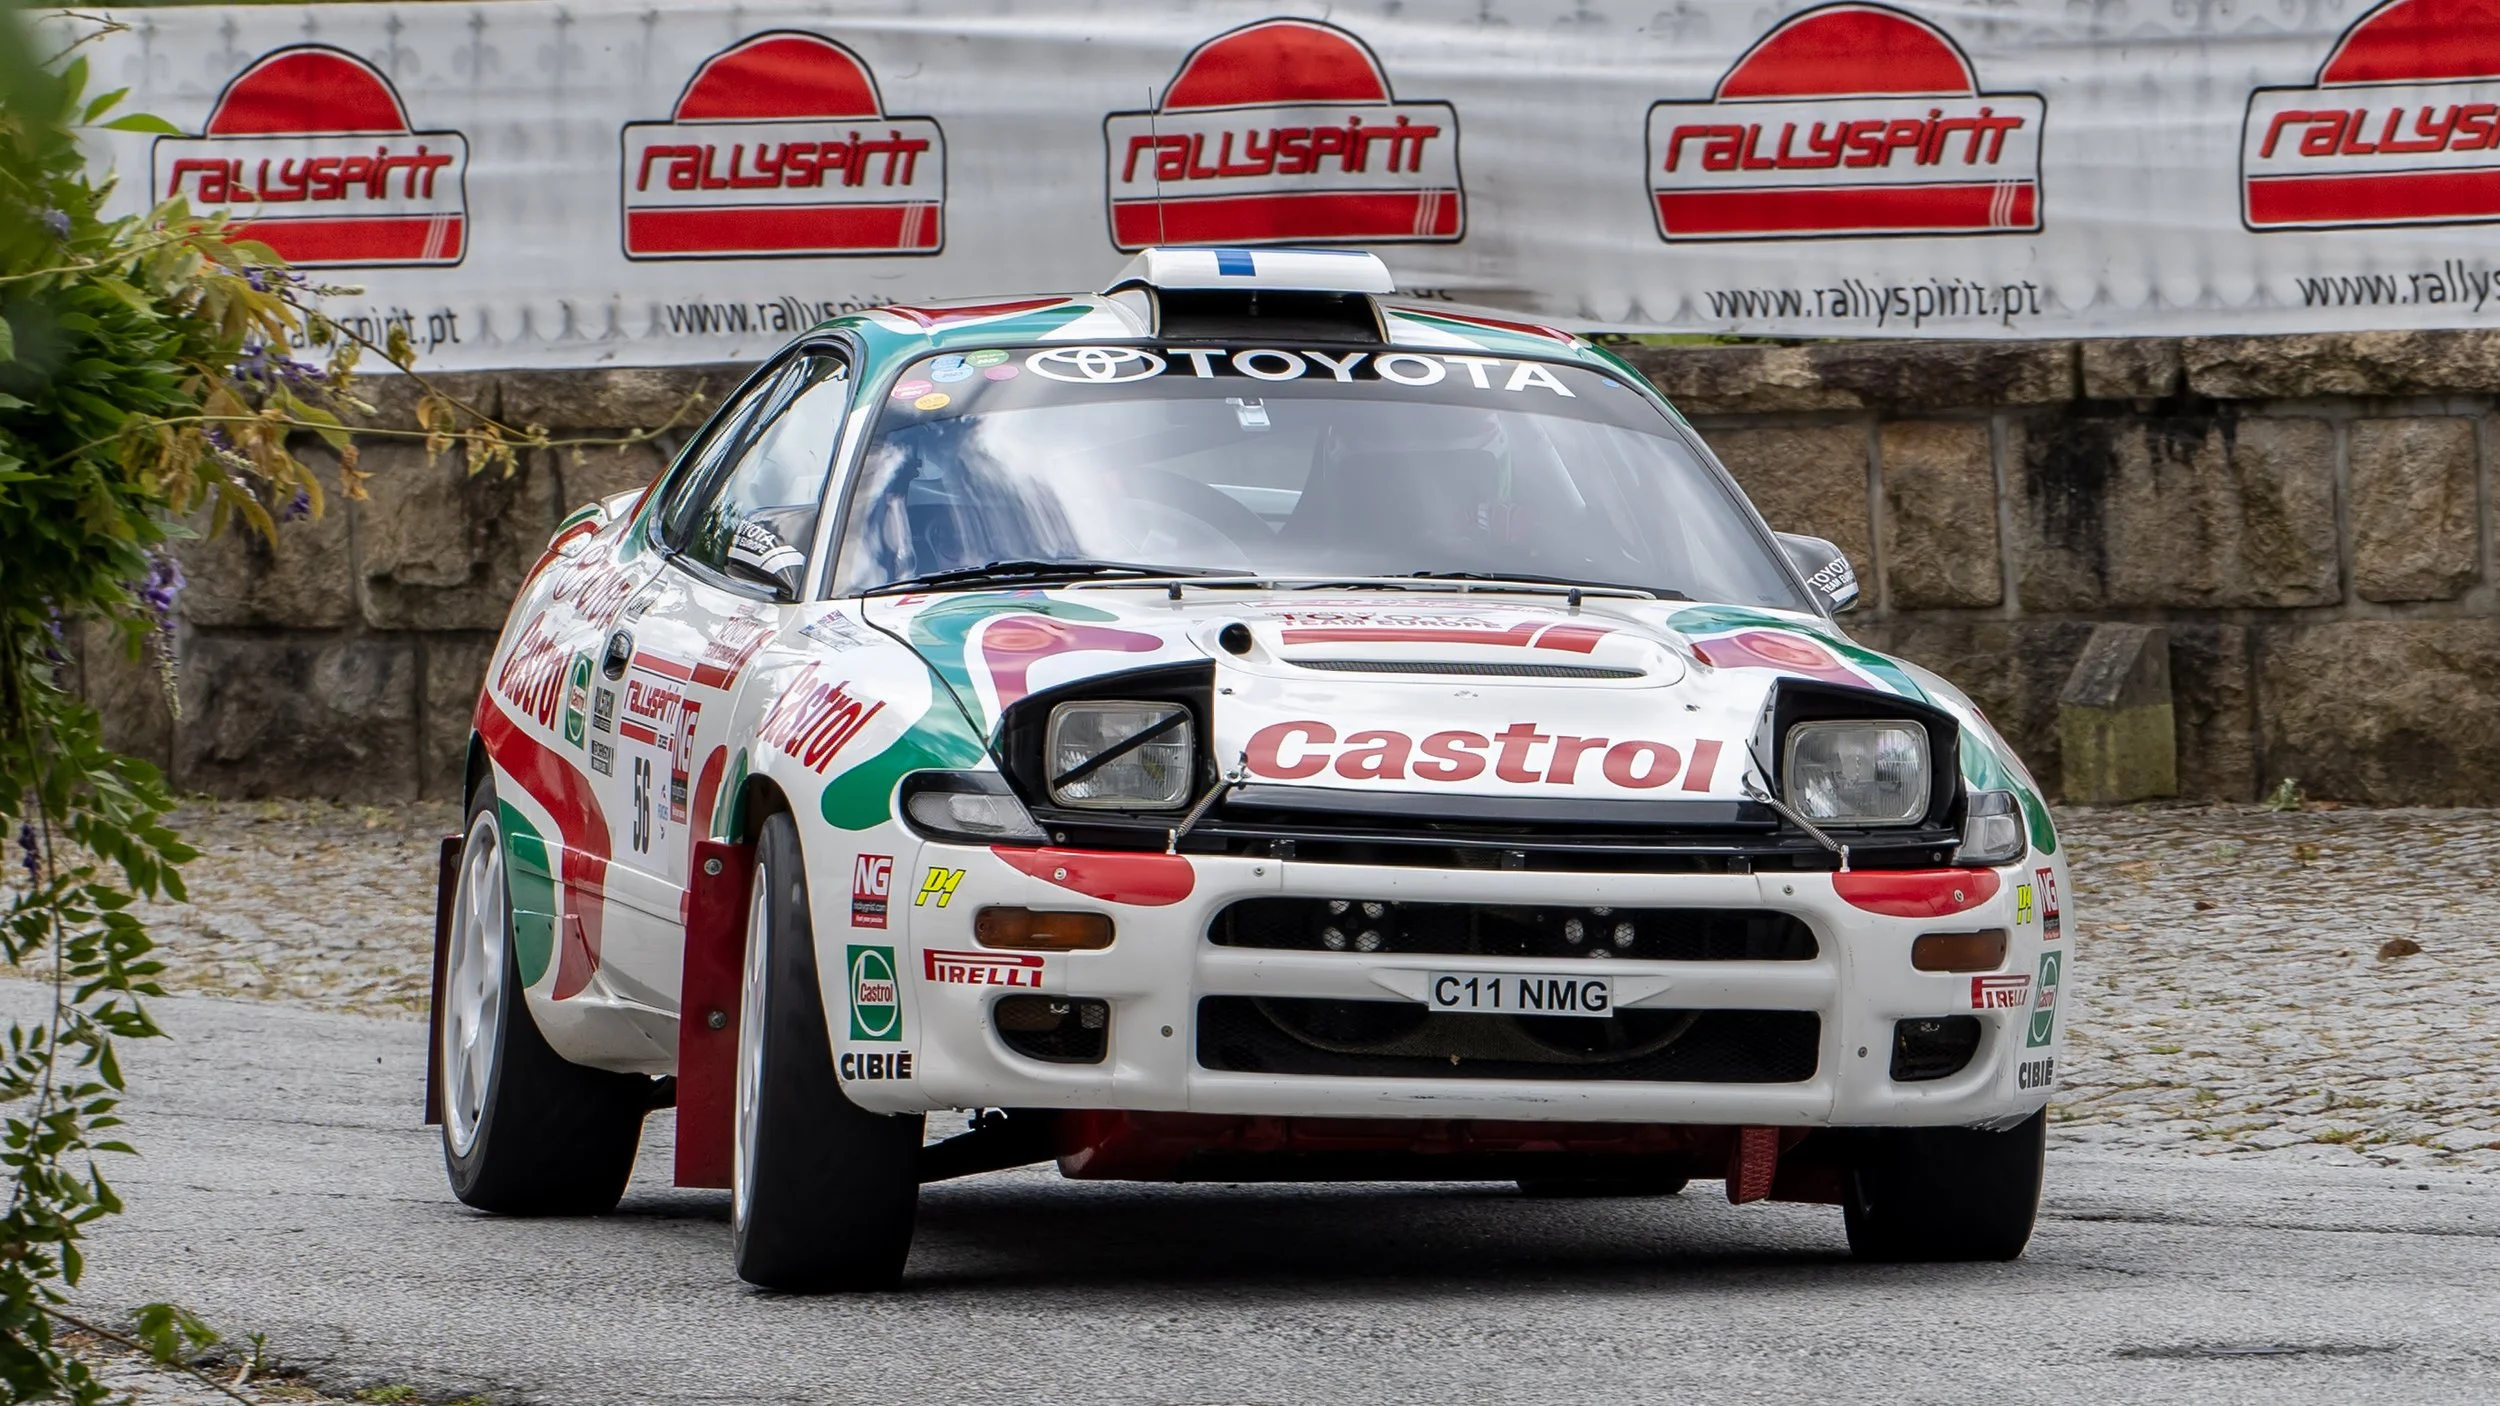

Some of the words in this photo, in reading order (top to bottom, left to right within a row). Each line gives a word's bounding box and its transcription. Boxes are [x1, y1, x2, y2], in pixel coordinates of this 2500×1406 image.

[2260, 103, 2500, 159] rallys
[1704, 278, 2042, 328] www.rallyspirit.pt
[1167, 348, 1577, 398] TOYOTA
[1279, 619, 1369, 627] TEAM
[498, 610, 576, 732] Castrol
[756, 660, 887, 775] Castrol
[1245, 720, 1723, 793] Castrol
[633, 756, 652, 855] 56
[855, 856, 892, 896] NG
[2037, 872, 2059, 914] NG
[923, 948, 1045, 988] PIRELLI
[860, 983, 893, 1003] Castrol
[1435, 976, 1501, 1008] C11
[1519, 979, 1608, 1012] NMG
[1971, 974, 2031, 1009] PIRELLI
